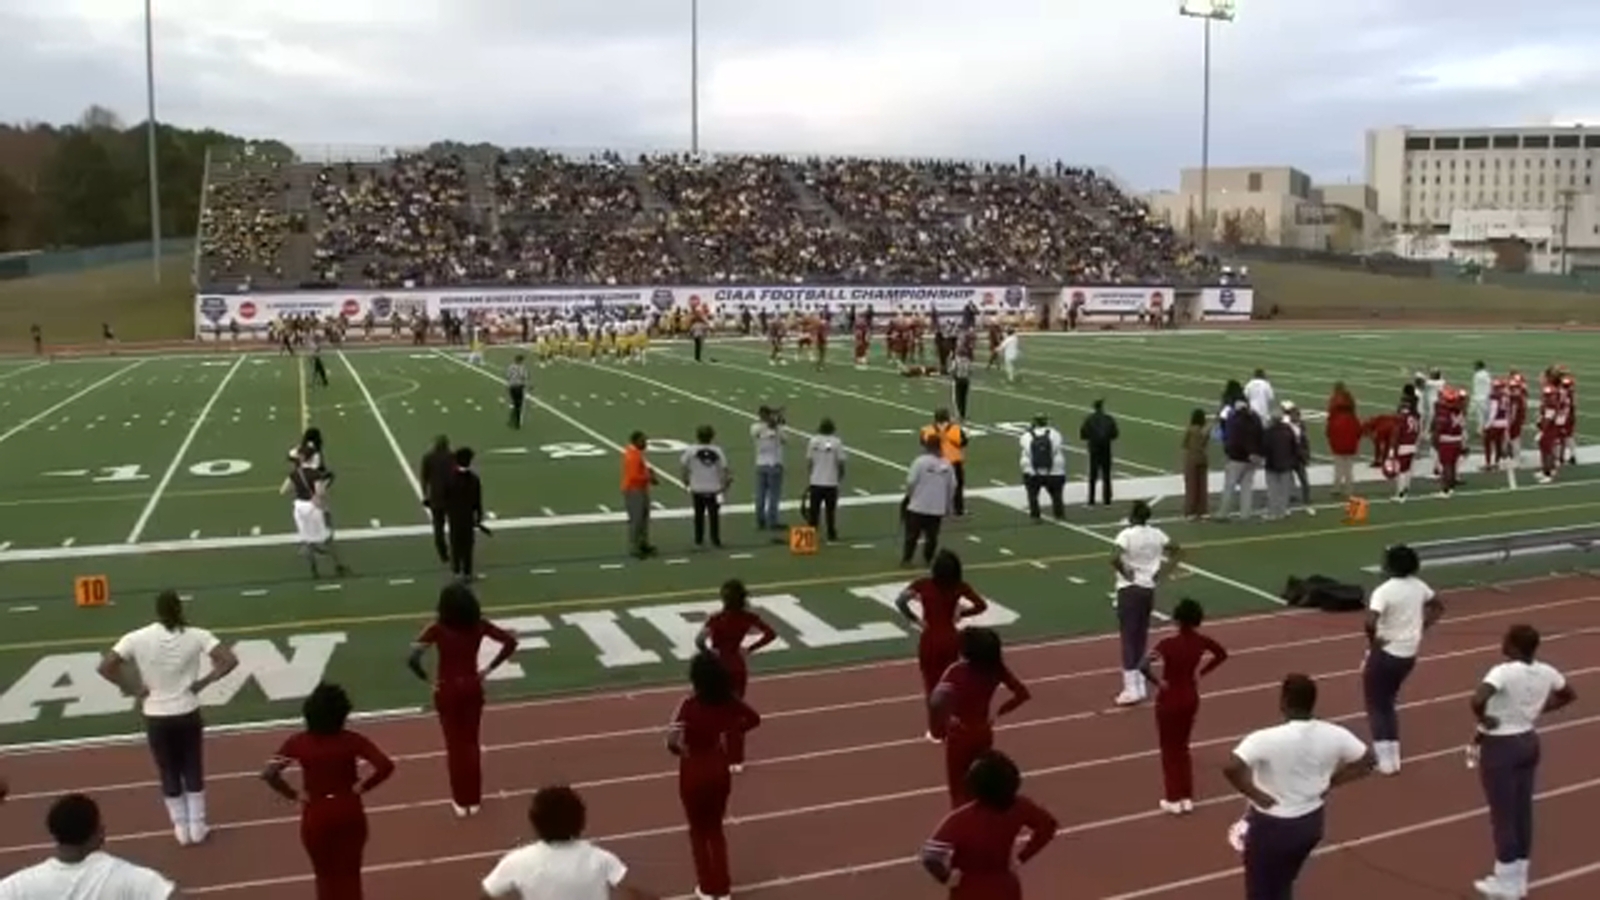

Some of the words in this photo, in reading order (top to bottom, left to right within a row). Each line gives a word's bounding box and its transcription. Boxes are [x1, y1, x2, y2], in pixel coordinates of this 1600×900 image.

[714, 289, 757, 301] CIAA
[759, 288, 846, 300] FOOTBALL
[851, 288, 976, 300] CHAMPIONSHIP
[794, 529, 815, 550] 20
[80, 578, 105, 604] 10
